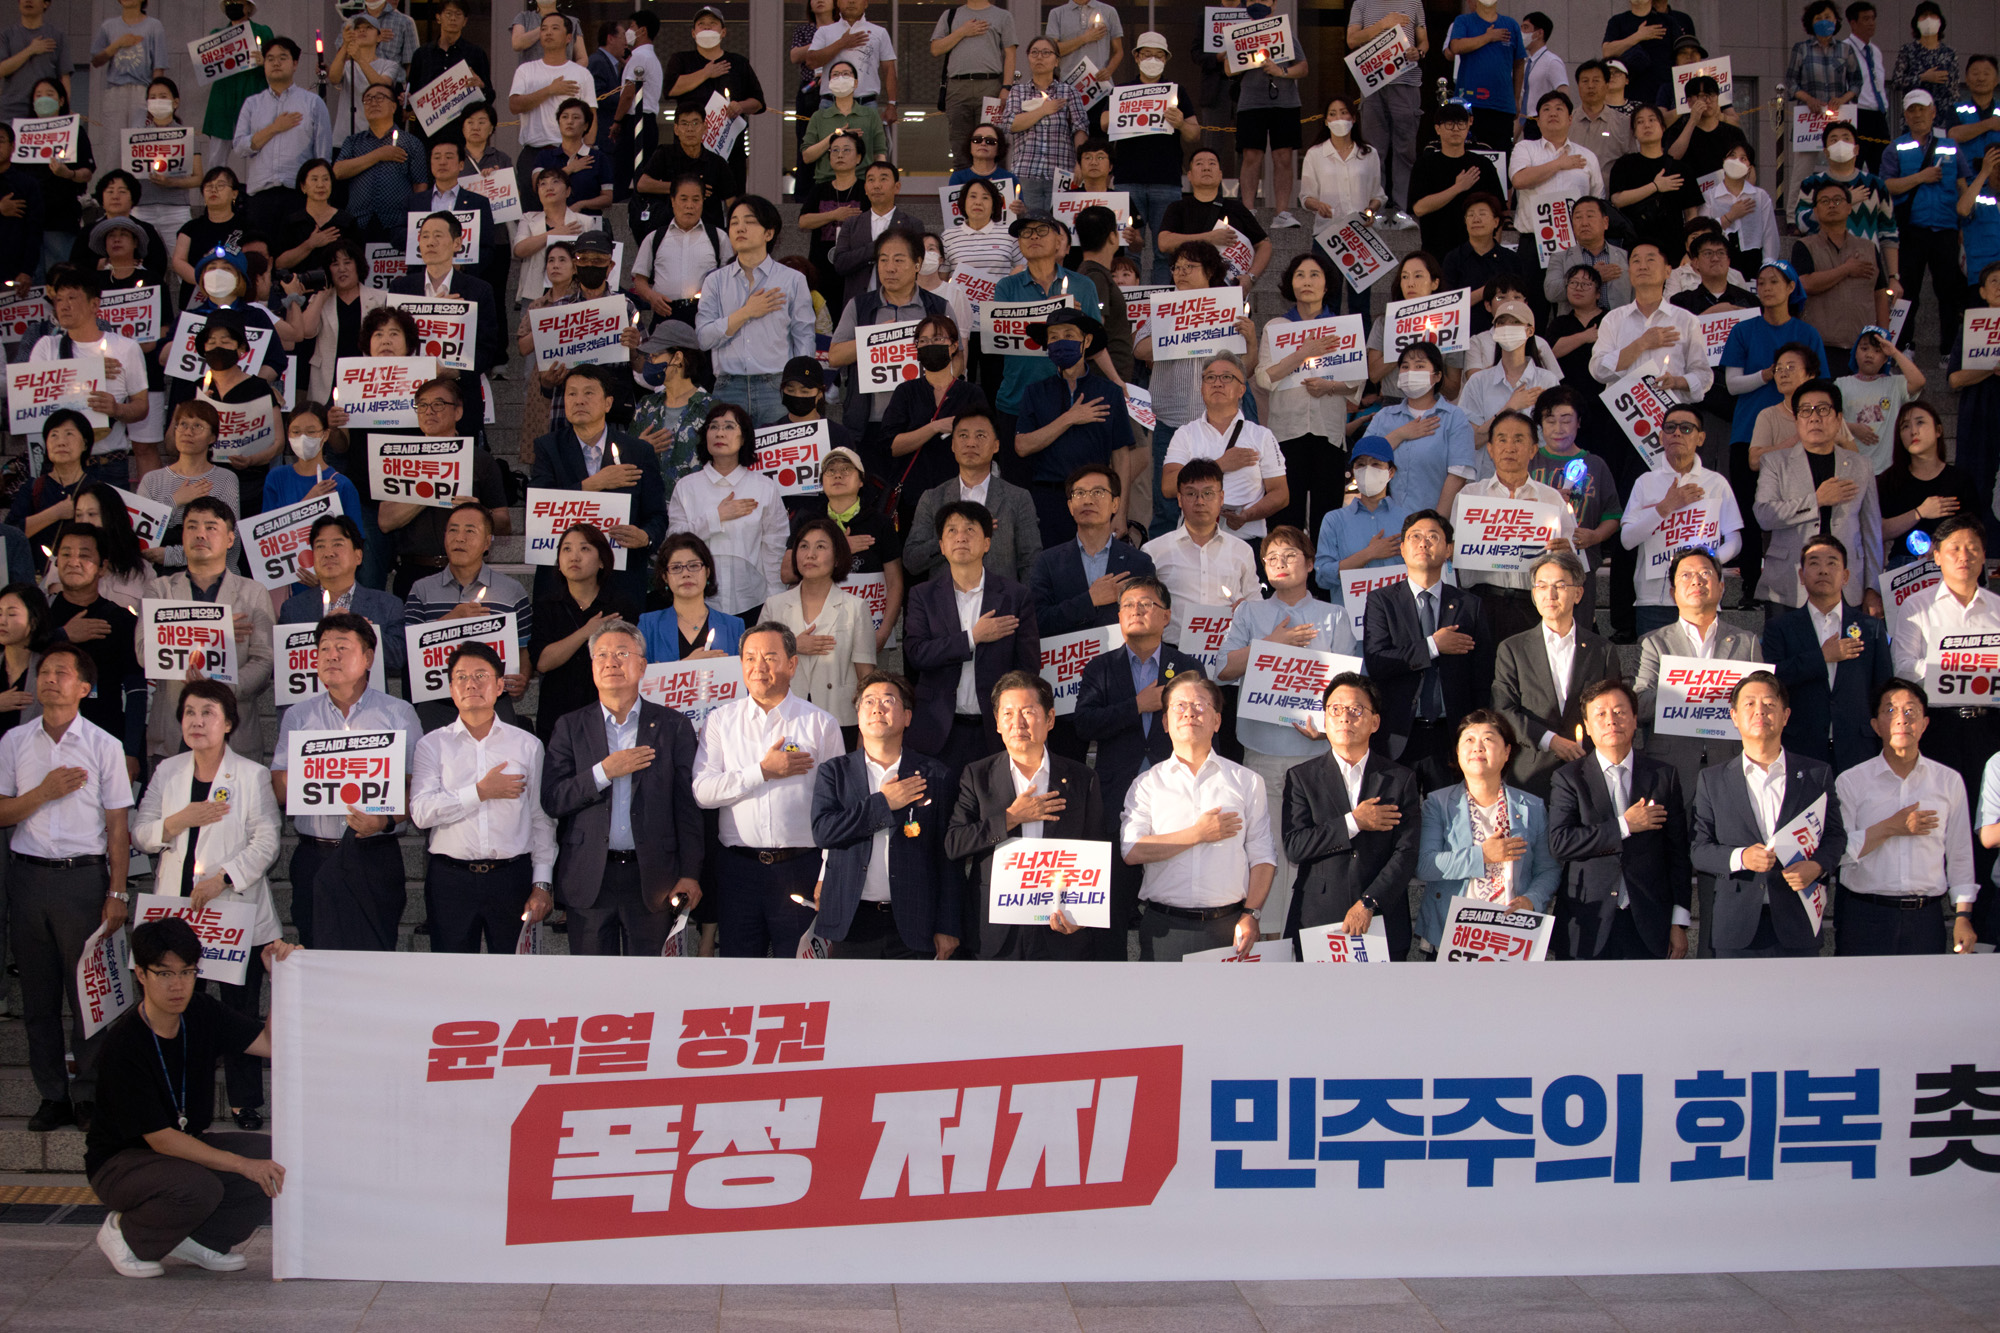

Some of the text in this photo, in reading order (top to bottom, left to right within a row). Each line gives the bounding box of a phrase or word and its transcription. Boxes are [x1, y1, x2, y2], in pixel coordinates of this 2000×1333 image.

[201, 38, 248, 66] 해양투기
[1234, 31, 1283, 53] 해양투기
[204, 51, 250, 78] STOP!
[1360, 42, 1404, 77] 해양투기
[1366, 53, 1408, 88] STOP!
[1119, 100, 1168, 114] 해양투기
[1117, 114, 1166, 128] STOP!
[21, 131, 70, 145] 해양투기
[131, 144, 185, 158] 해양투기
[132, 158, 185, 174] STOP!
[1327, 235, 1370, 281] STOP!
[1339, 226, 1381, 274] 해양투기
[373, 260, 408, 274] 해양투
[1157, 297, 1216, 319] 무너지는
[110, 321, 152, 339] TOP!
[416, 319, 465, 341] 양투기
[538, 309, 600, 334] 무너지는
[559, 316, 621, 344] 민주주의
[1175, 308, 1236, 331] 민주주의
[1395, 310, 1461, 335] 해양투기
[1702, 317, 1740, 335] 너지는
[416, 341, 464, 362] TOP!
[542, 341, 566, 360] 다시
[1159, 334, 1180, 348] 다시
[1395, 328, 1460, 354] STOP!
[870, 344, 919, 364] 해양투
[1969, 347, 1989, 358] 다시
[14, 367, 78, 391] 무너지는
[343, 366, 408, 384] 무너지는
[871, 364, 919, 384] STO
[16, 406, 38, 421] 다시
[218, 411, 246, 425] 지는
[344, 403, 366, 414] 다시
[383, 440, 458, 455] 후쿠시마 핵오염수
[383, 458, 459, 480] 해양투기
[383, 478, 459, 500] STOP!
[532, 501, 601, 518] 무너지는
[1464, 508, 1534, 526] 무너지는
[258, 524, 315, 558] 해양투
[531, 539, 556, 551] 다시
[1481, 526, 1552, 543] 민주주의
[1460, 544, 1485, 556] 다시
[1652, 548, 1671, 566] 다시
[157, 608, 222, 622] 후쿠시마 핵오염수
[157, 625, 225, 649] 해양투기
[421, 617, 503, 646] 후쿠시마 핵오염수
[1943, 635, 2000, 650] 후쿠시마 핵오
[158, 648, 226, 674] STOP!
[1254, 654, 1331, 679] 무너지는
[1940, 652, 1999, 673] 해양투
[1271, 678, 1331, 698] 민주주
[1666, 670, 1741, 687] 무너지는
[1247, 691, 1326, 712] 다시 세우겠습
[1663, 706, 1687, 720] 다시
[306, 734, 391, 755] 후쿠시마 핵오염수
[304, 757, 391, 780] 해양투기
[303, 781, 391, 805] STOP!
[1020, 869, 1101, 889] 민주주의
[997, 891, 1025, 907] 다시
[1458, 910, 1493, 924] 후쿠시마
[1452, 925, 1534, 961] 해양투기
[104, 938, 119, 982] 세우겠습
[84, 955, 103, 1024] 무너지는
[426, 1001, 830, 1082] 윤석열 정권
[1210, 1073, 1643, 1189] 민주주의
[1670, 1068, 1882, 1182] 회복
[551, 1075, 1138, 1213] 폭정 저지
